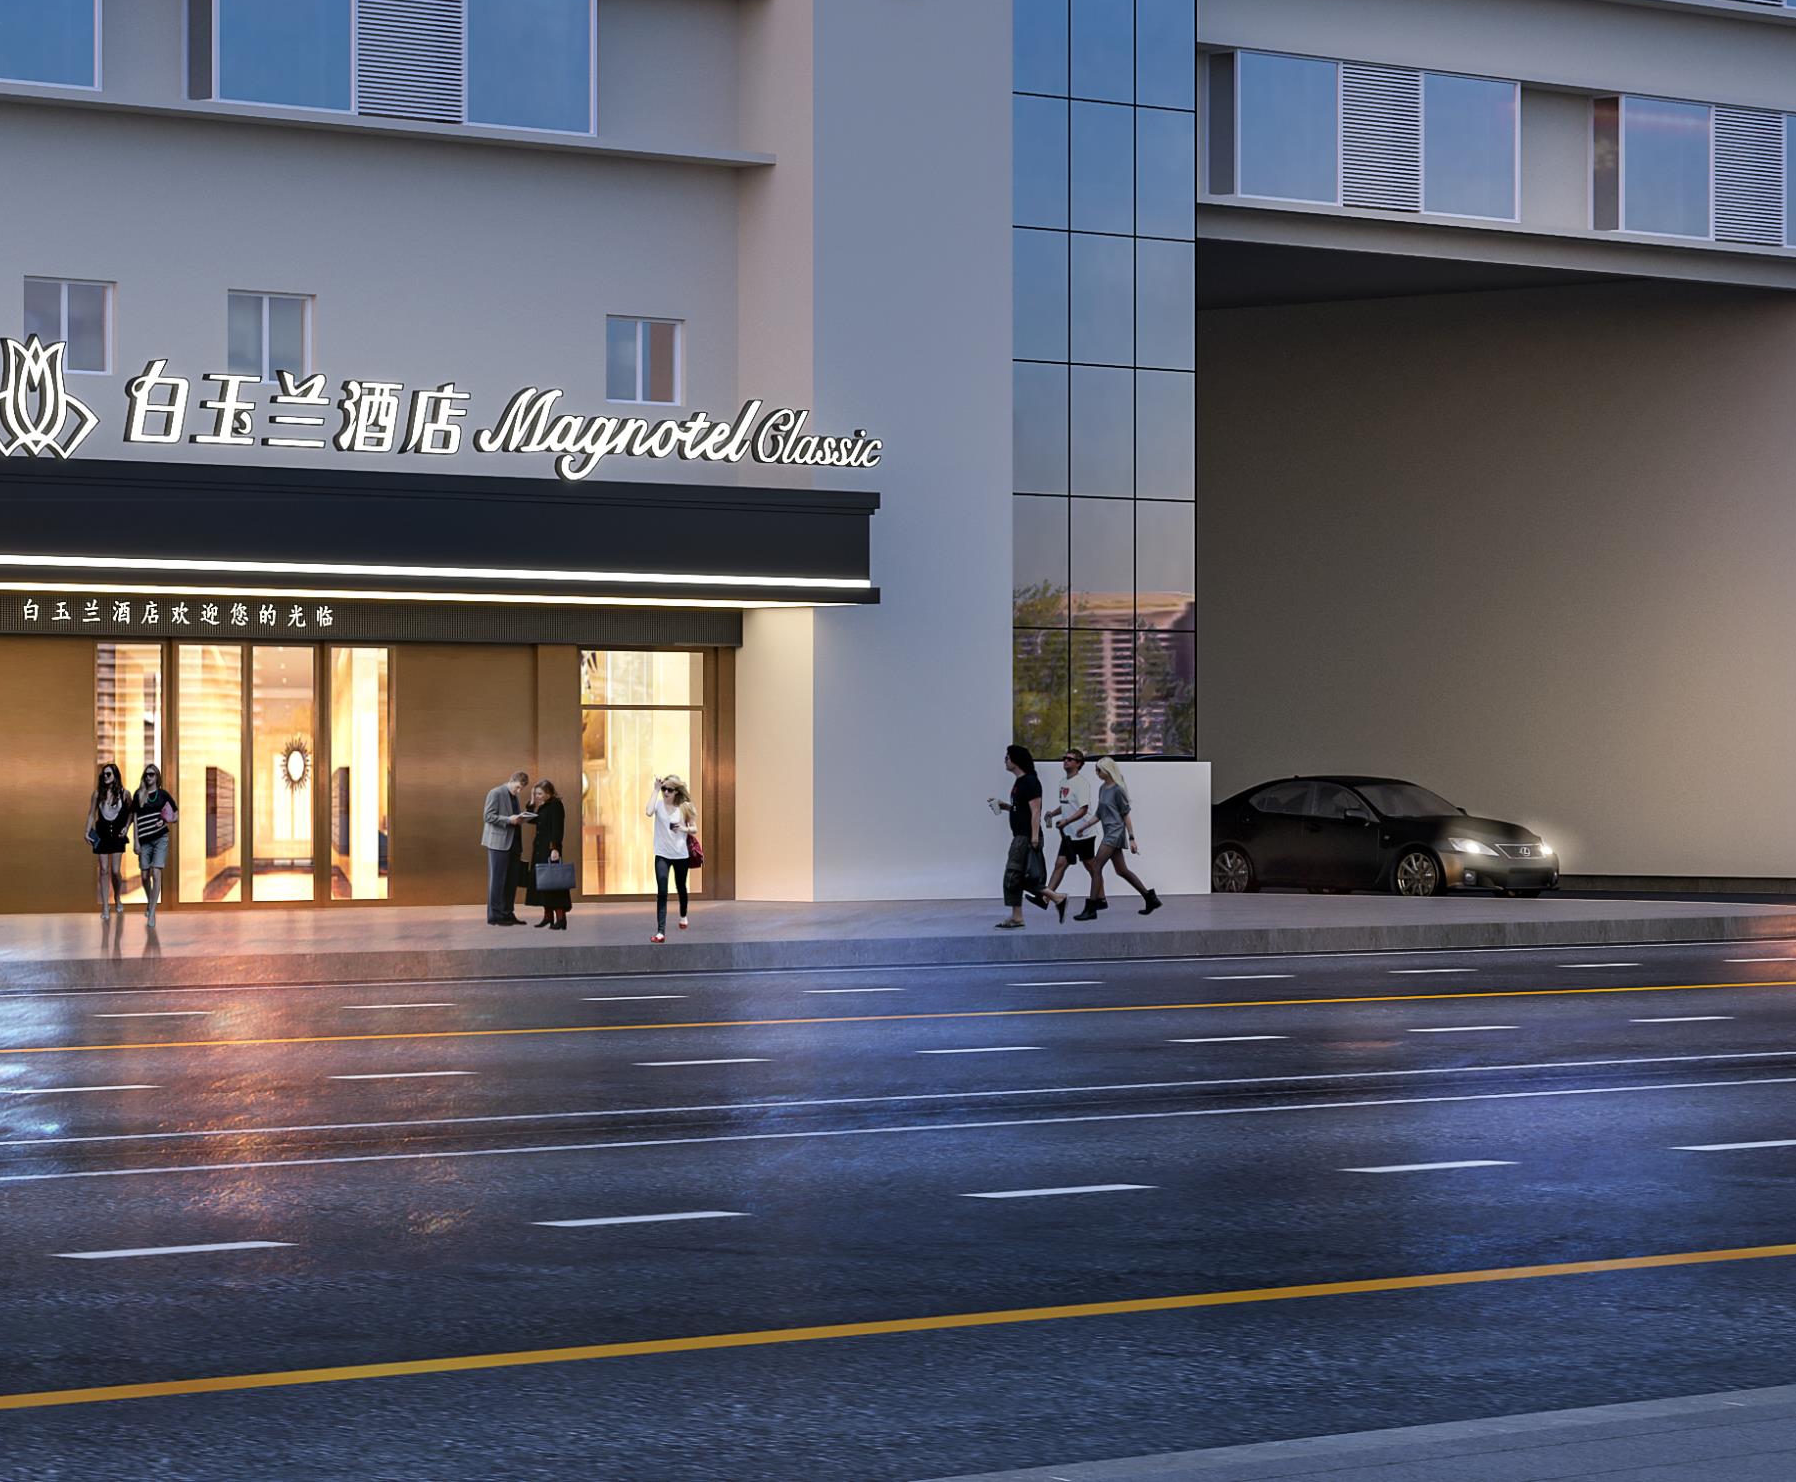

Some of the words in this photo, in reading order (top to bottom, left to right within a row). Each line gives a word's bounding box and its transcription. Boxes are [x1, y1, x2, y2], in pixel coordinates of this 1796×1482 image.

[123, 359, 472, 455] 白玉兰酒店
[473, 386, 763, 481] Magnotel
[752, 407, 884, 468] Classic
[22, 598, 334, 628] 白玉兰酒店欢迎您的光临
